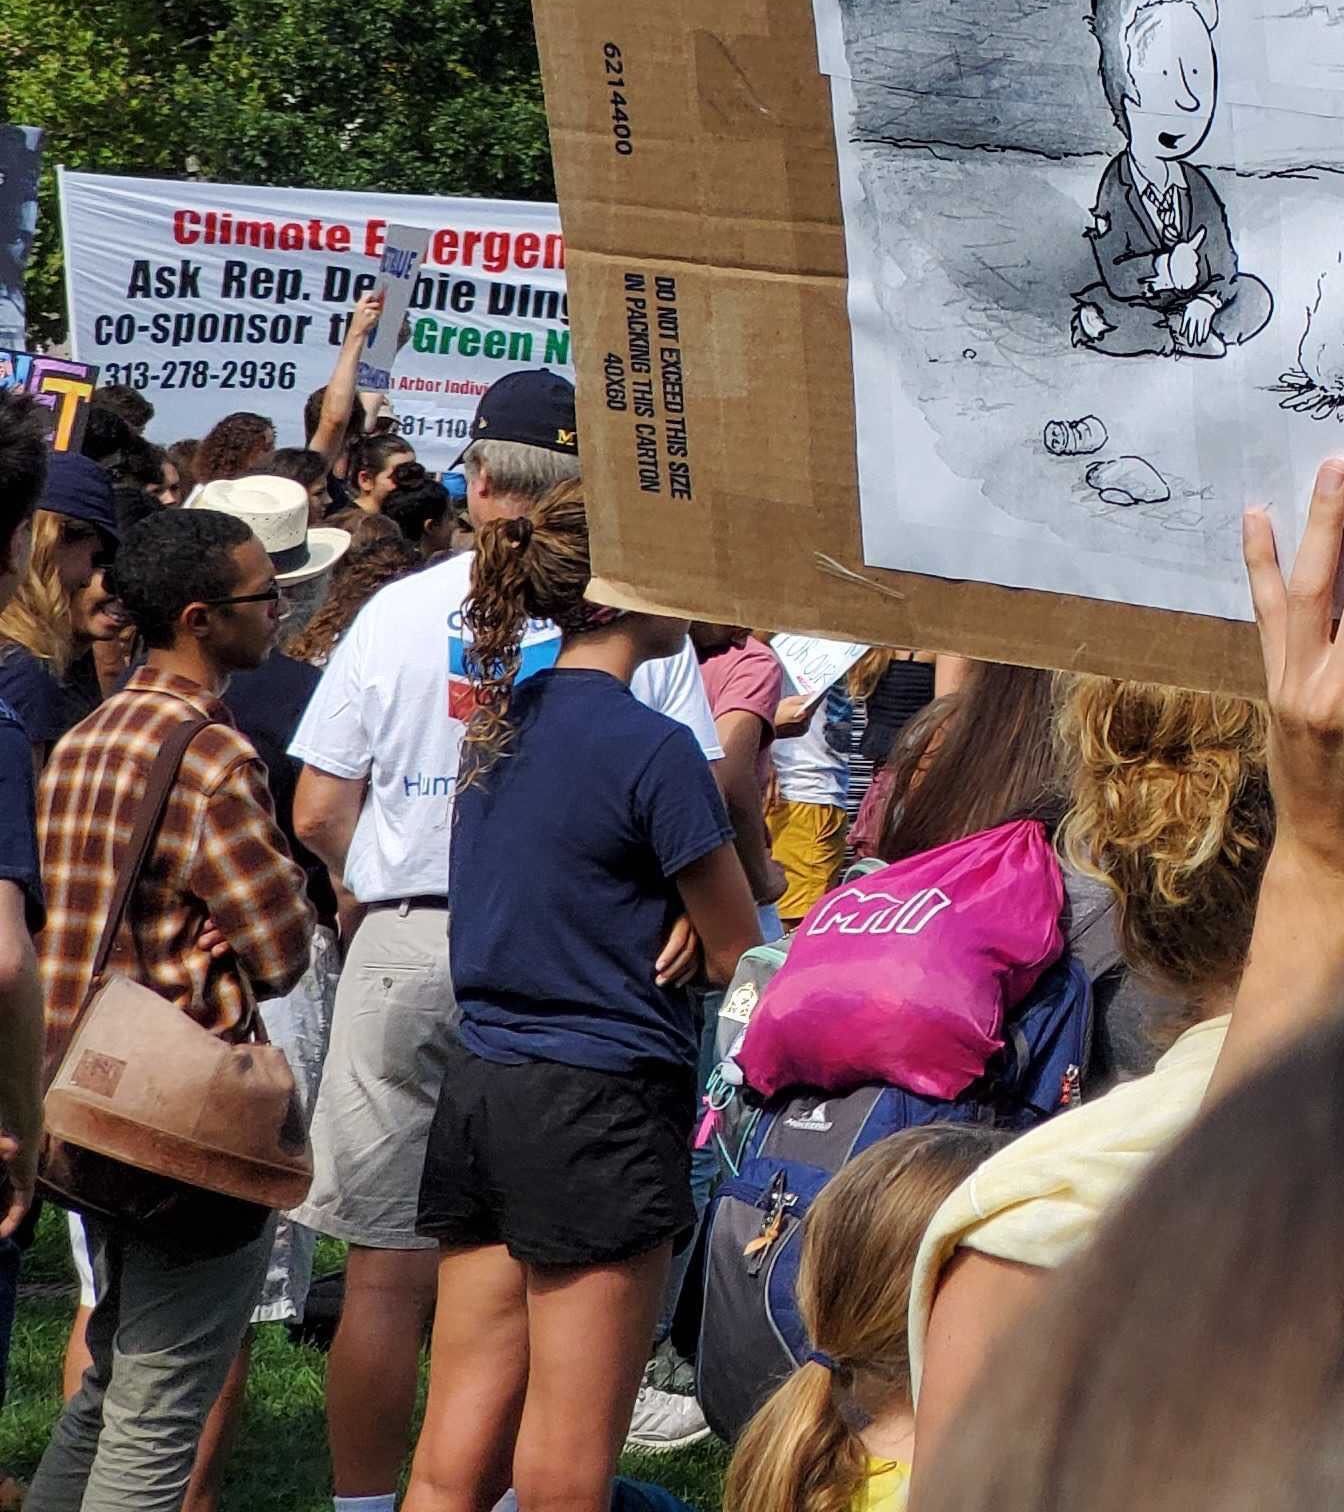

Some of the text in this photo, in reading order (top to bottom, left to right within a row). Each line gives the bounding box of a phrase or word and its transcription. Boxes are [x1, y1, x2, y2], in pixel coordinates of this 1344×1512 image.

[603, 41, 633, 156] 6214400
[173, 209, 352, 252] Climate
[127, 259, 202, 299] Ask
[221, 260, 310, 304] Rep.
[323, 265, 476, 314] Debie
[95, 311, 312, 347] co-sponsor
[412, 317, 533, 362] Green
[105, 360, 296, 390] 313-278-2936
[400, 376, 441, 393] Arbor
[603, 352, 626, 412] 40X60
[624, 272, 661, 494] IN PACKING THIS CARTON
[654, 276, 693, 501] DO NOT EXCEED THIS SIZE
